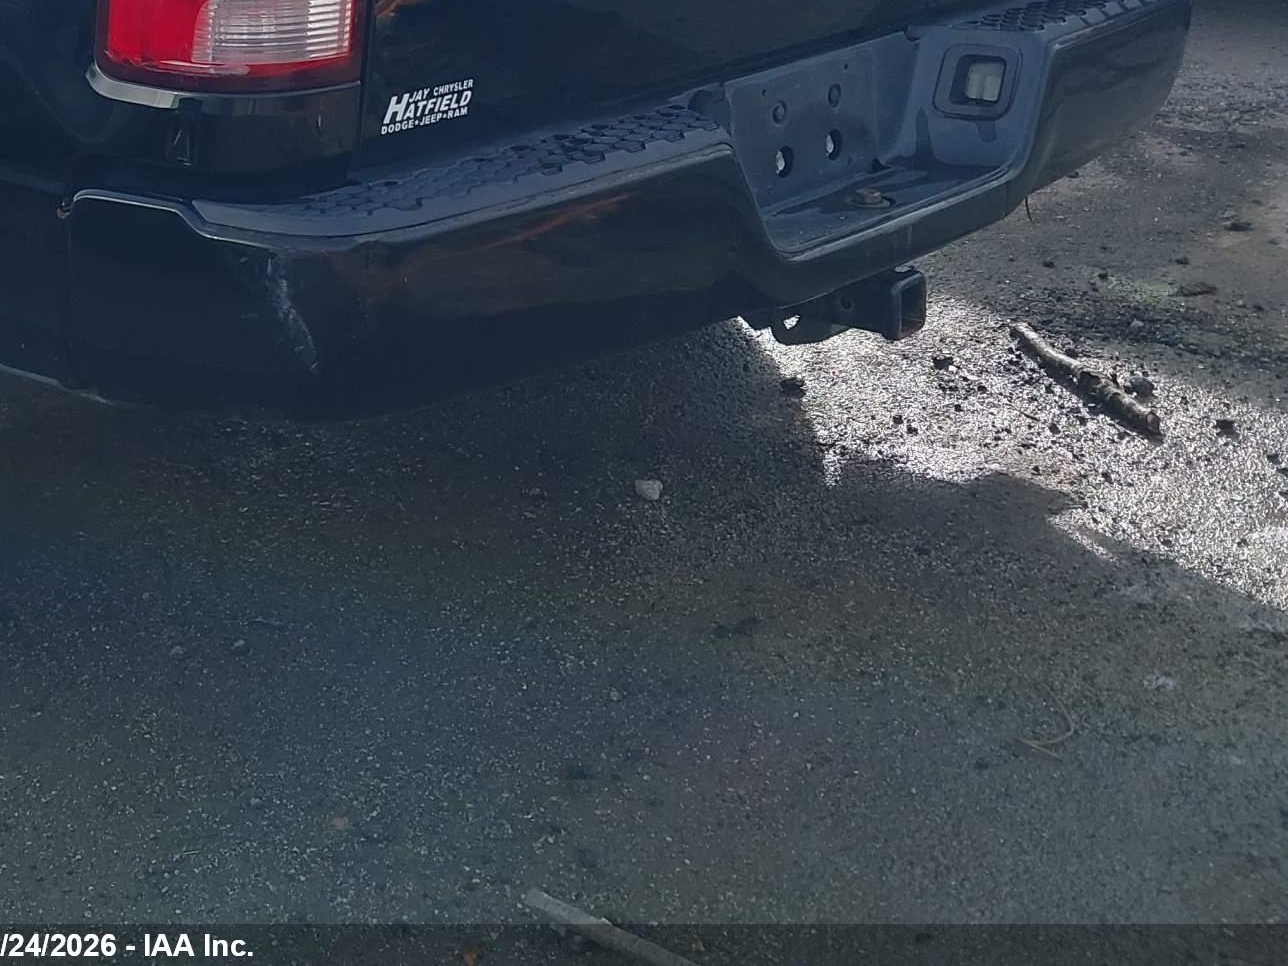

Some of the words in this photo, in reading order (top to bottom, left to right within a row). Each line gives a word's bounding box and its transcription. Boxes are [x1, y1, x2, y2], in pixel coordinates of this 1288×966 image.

[409, 88, 430, 103] JAY
[433, 79, 474, 96] CHRYSLER
[381, 119, 414, 135] DODGE
[420, 112, 442, 126] JEEP
[447, 106, 468, 119] RAM
[383, 90, 472, 124] HATFIELD
